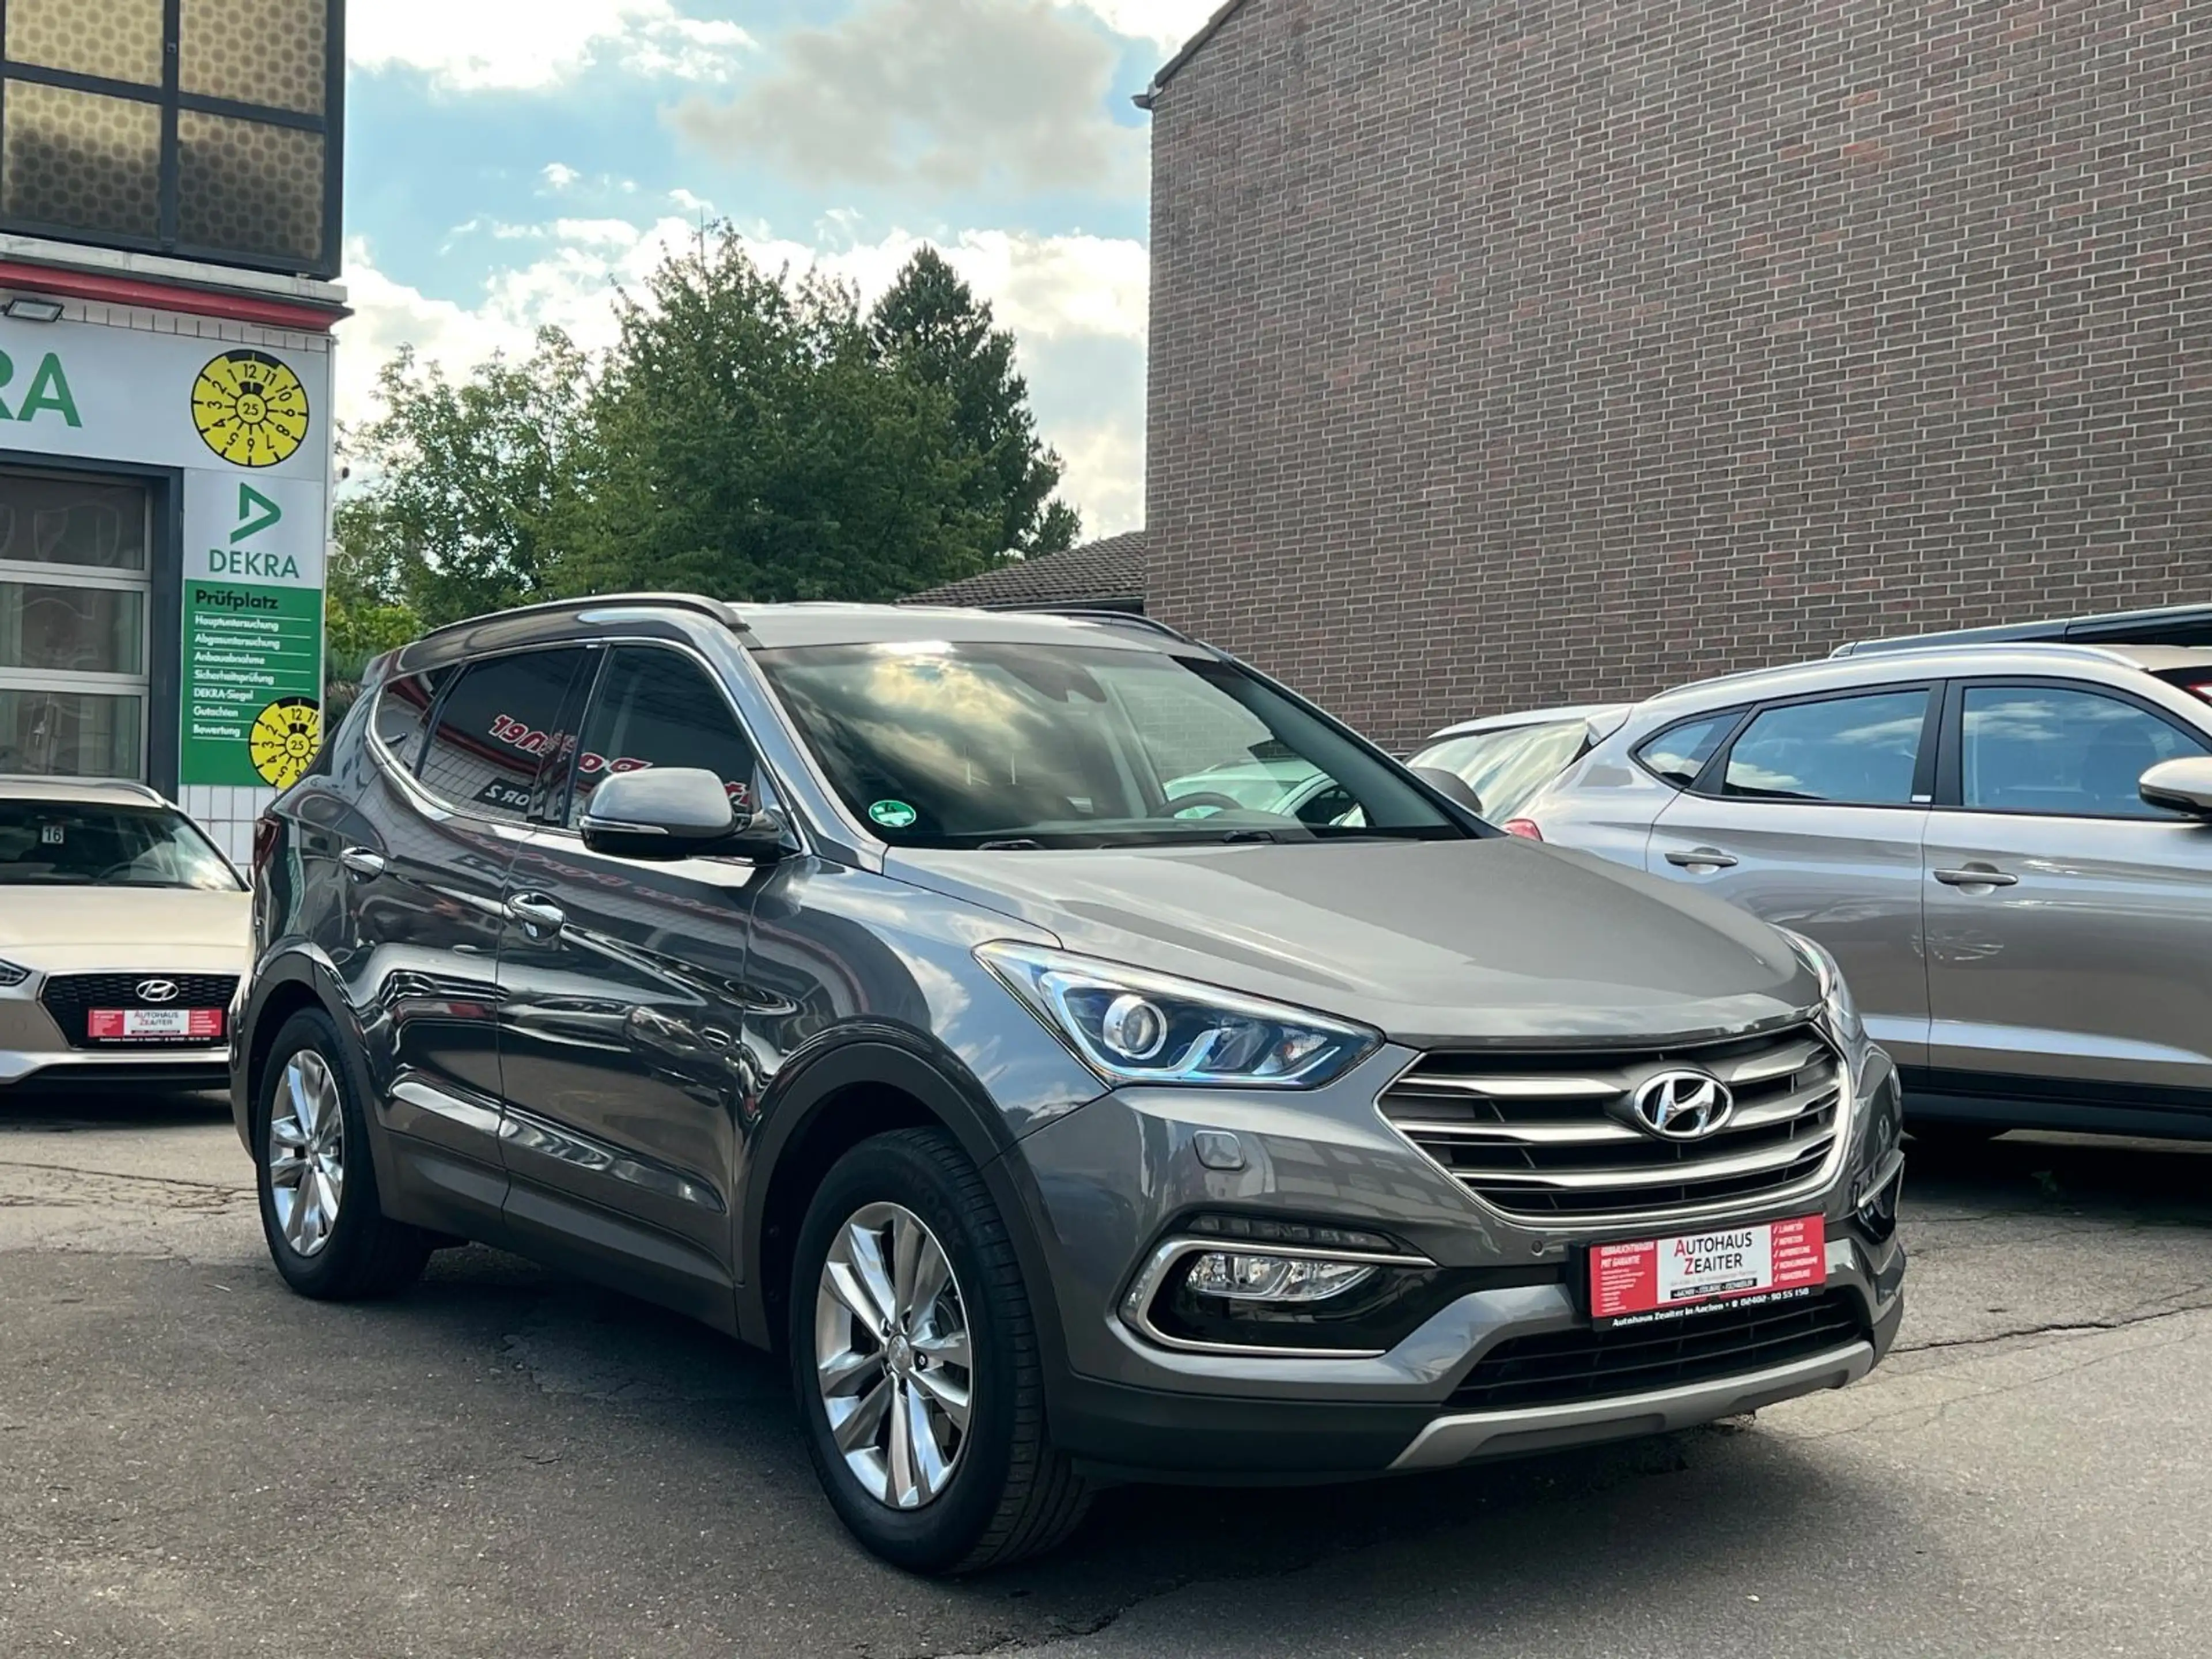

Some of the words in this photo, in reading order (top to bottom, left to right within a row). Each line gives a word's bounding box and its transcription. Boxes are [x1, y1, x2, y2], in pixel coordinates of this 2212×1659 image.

[226, 368, 237, 383] 1
[243, 363, 257, 380] 12
[263, 369, 278, 387] 11
[211, 380, 228, 395] 2
[275, 384, 293, 402] 10
[207, 400, 223, 410] 3
[243, 403, 259, 416] 25
[211, 418, 226, 428] 4
[275, 423, 291, 437] 8
[226, 432, 240, 446] 5
[266, 434, 275, 450] 7
[209, 548, 300, 579] DEKRA
[195, 588, 279, 612] Prüfplatz
[195, 614, 279, 632] Hauptuntersuchung
[195, 633, 281, 650] Abgasuntersuchung
[194, 651, 266, 665] Anbauabnahme
[194, 669, 275, 686] Sicherheitsprüfung
[193, 687, 254, 702] DEKRA-Siegel
[193, 705, 239, 718] Gutachten
[291, 708, 302, 721] 12
[307, 711, 319, 726] 11
[193, 724, 241, 738] Bewertung
[265, 724, 279, 736] 2
[262, 740, 275, 749] 3
[290, 740, 304, 751] 25
[266, 755, 278, 764] 4
[278, 766, 288, 778] 5
[45, 828, 61, 842] 16
[1674, 1231, 1753, 1257] AUTOHAUS
[1684, 1252, 1743, 1275] ZEAITER
[1612, 1314, 1653, 1327] Autohaus
[1654, 1309, 1684, 1321] Zeaiter
[1694, 1303, 1724, 1314] Aachen
